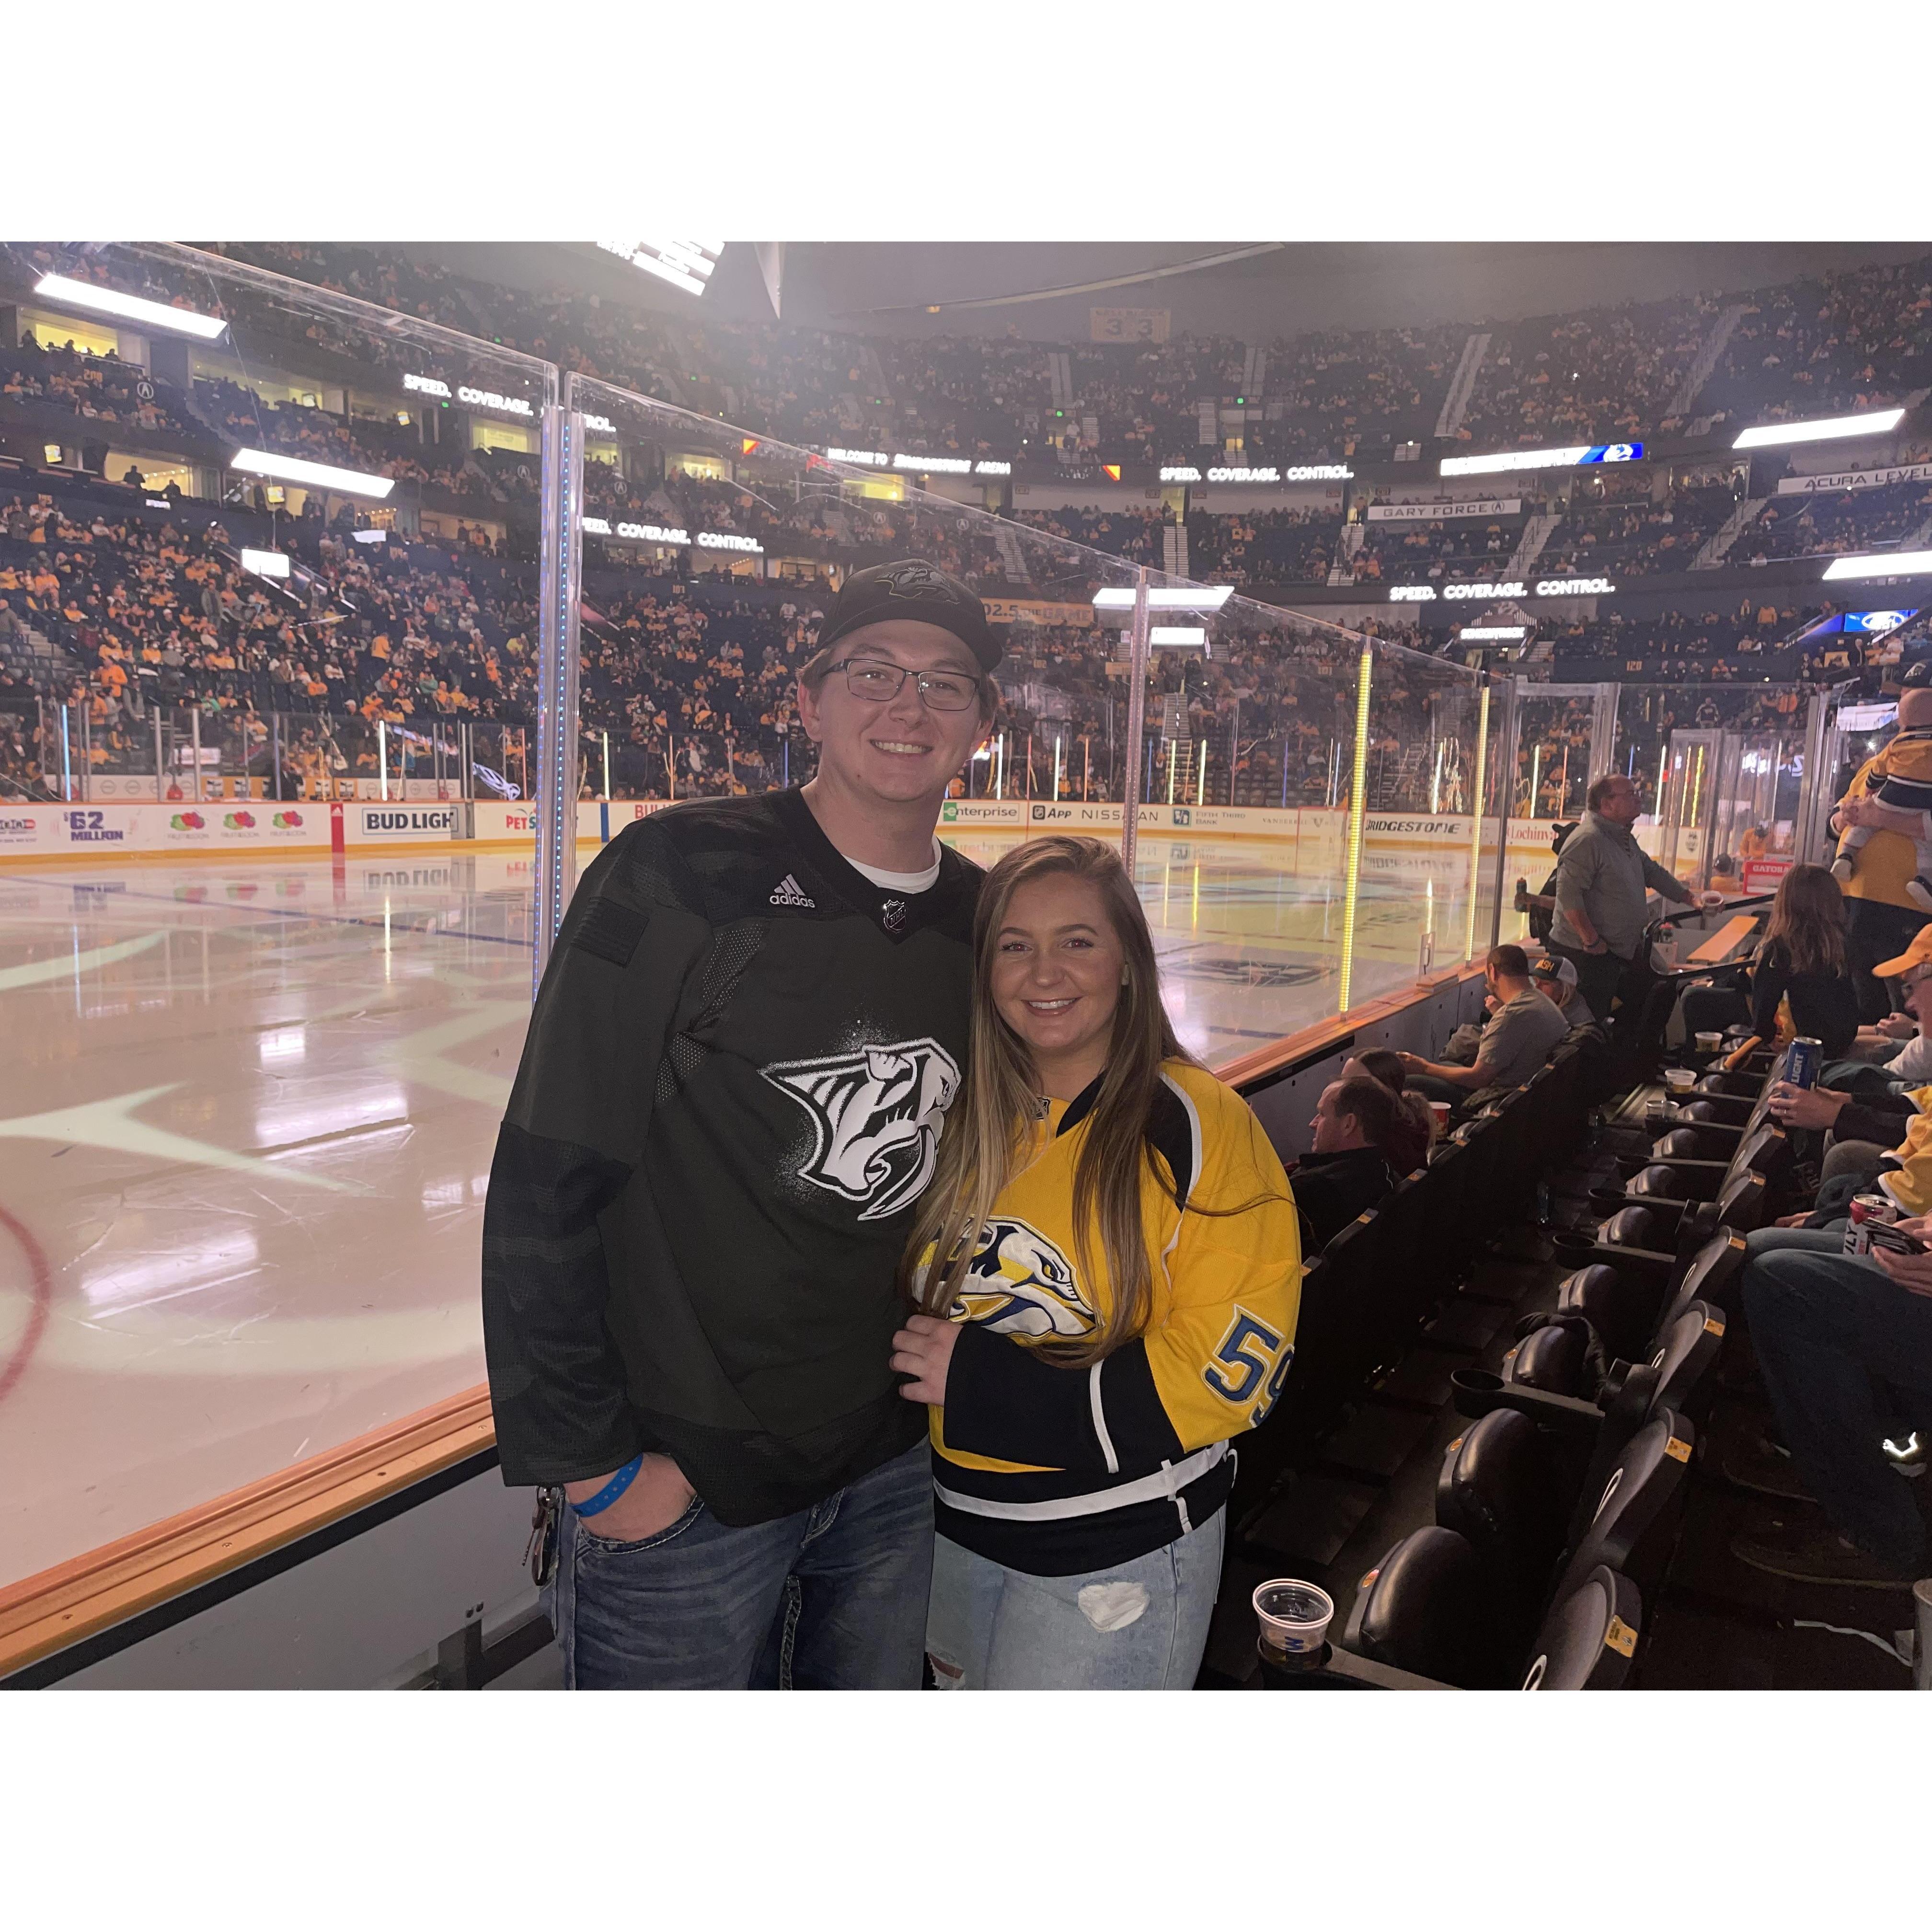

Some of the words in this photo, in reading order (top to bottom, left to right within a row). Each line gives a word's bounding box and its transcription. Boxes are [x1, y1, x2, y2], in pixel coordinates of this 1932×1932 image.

[404, 374, 452, 398] SPEED.
[458, 387, 534, 416] COVERAGE.
[1160, 467, 1202, 481] SPEED.
[1208, 467, 1280, 481] COVERAGE.
[1288, 465, 1354, 480] CONTROL.
[1805, 474, 1867, 488] ACURA
[1875, 467, 1932, 482] LEVEL
[1383, 506, 1430, 518] GARY
[1433, 504, 1487, 516] FORCE
[618, 522, 691, 544] COVERAGE.
[698, 532, 764, 552] CONTROL.
[1390, 586, 1437, 601] SPEED.
[1444, 582, 1528, 599] COVERAGE.
[1536, 578, 1615, 596] CONTROL.
[982, 603, 1019, 617] 02.5
[945, 805, 1017, 818] enterprise
[367, 813, 408, 829] BUD
[71, 830, 124, 841] MILLION
[1512, 824, 1557, 840] Lochinva
[1753, 864, 1789, 873] GATORA
[770, 893, 816, 908] adidas
